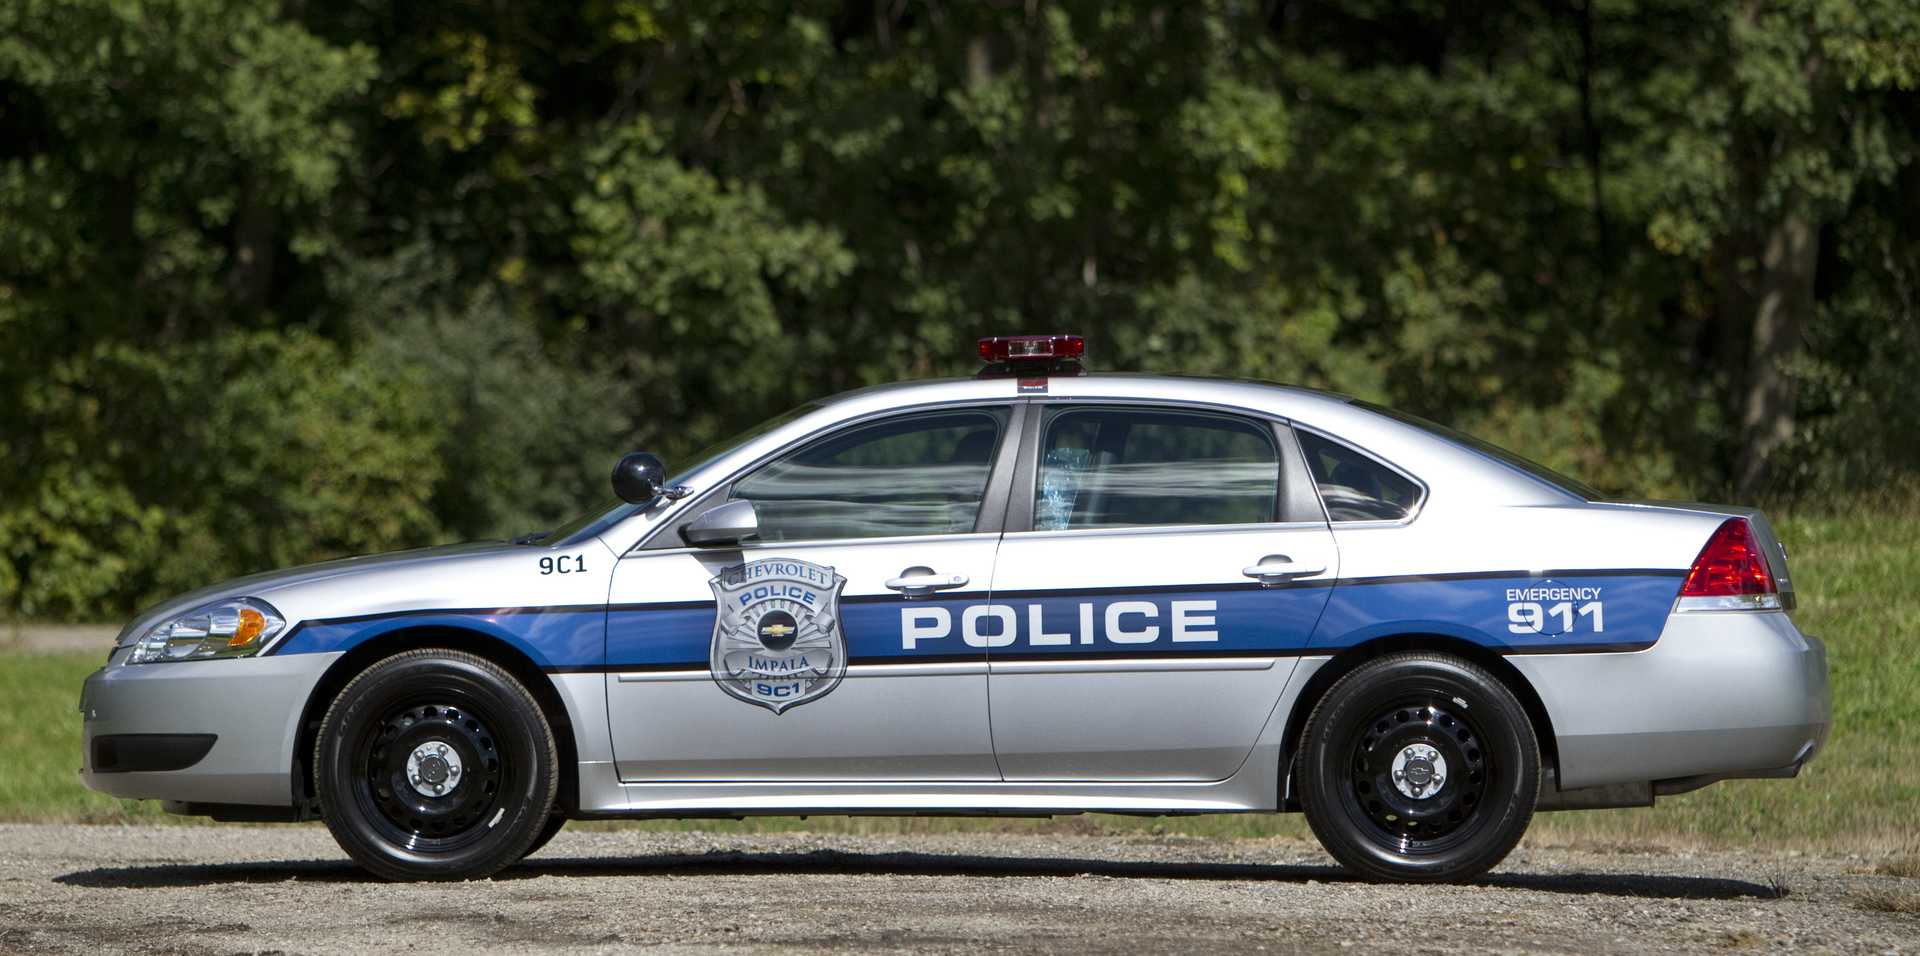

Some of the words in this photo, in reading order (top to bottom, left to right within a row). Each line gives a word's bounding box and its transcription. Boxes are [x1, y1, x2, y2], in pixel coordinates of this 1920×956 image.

[539, 554, 587, 575] 9C1
[728, 563, 828, 585] CHEVROLET
[739, 585, 816, 606] POLICE
[1506, 587, 1602, 601] EMERGENCY
[901, 600, 1219, 650] POLICE
[1507, 601, 1604, 634] 911
[749, 655, 809, 672] IMPALA
[757, 682, 800, 697] 9C1
